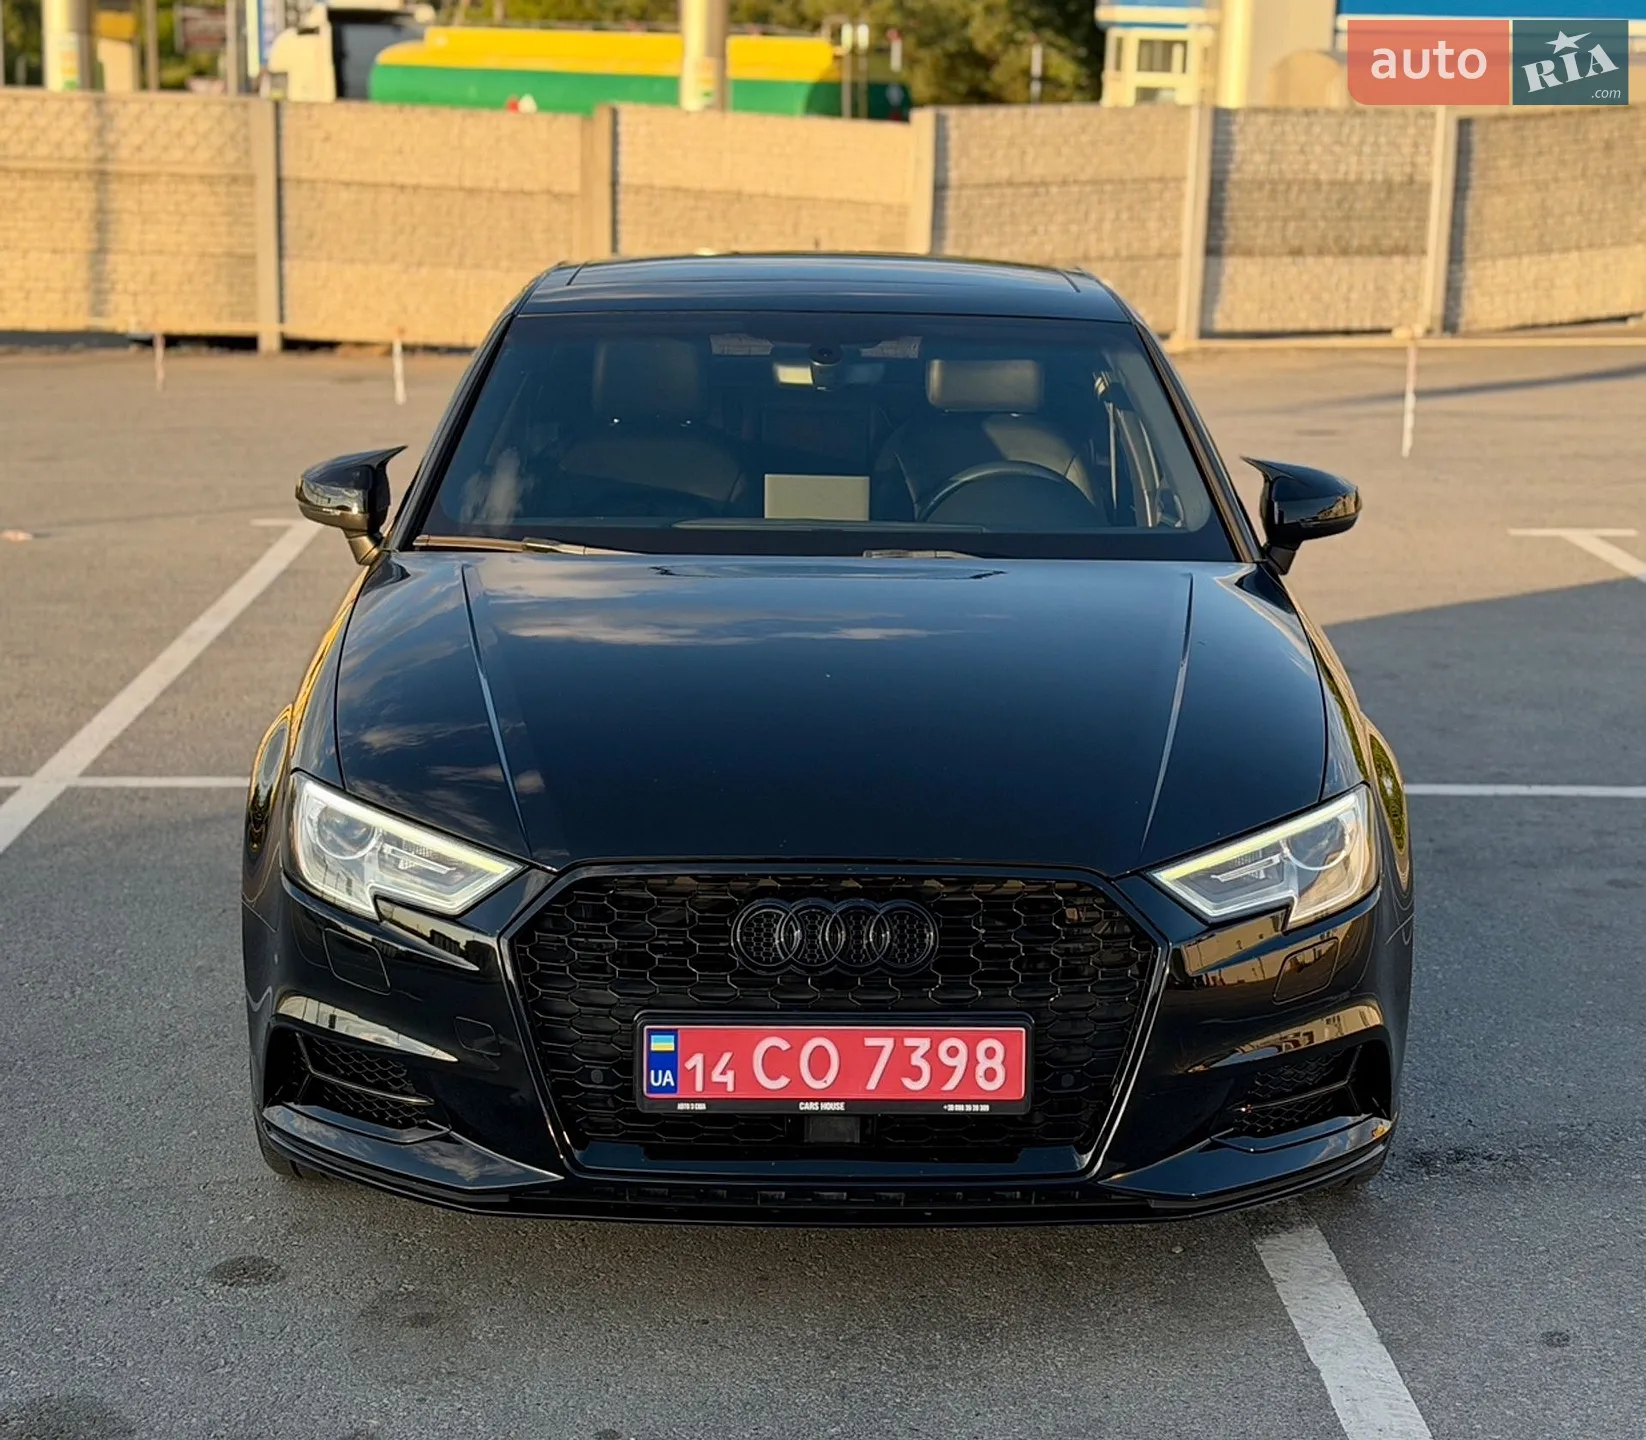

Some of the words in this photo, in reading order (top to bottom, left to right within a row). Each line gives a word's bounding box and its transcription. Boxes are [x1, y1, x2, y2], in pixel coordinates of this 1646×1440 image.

[684, 1051, 736, 1093] 14
[752, 1036, 840, 1091] CO
[863, 1037, 1007, 1092] 7398
[650, 1069, 675, 1087] UA
[798, 1101, 820, 1111] CARS
[820, 1101, 846, 1111] HOUSE
